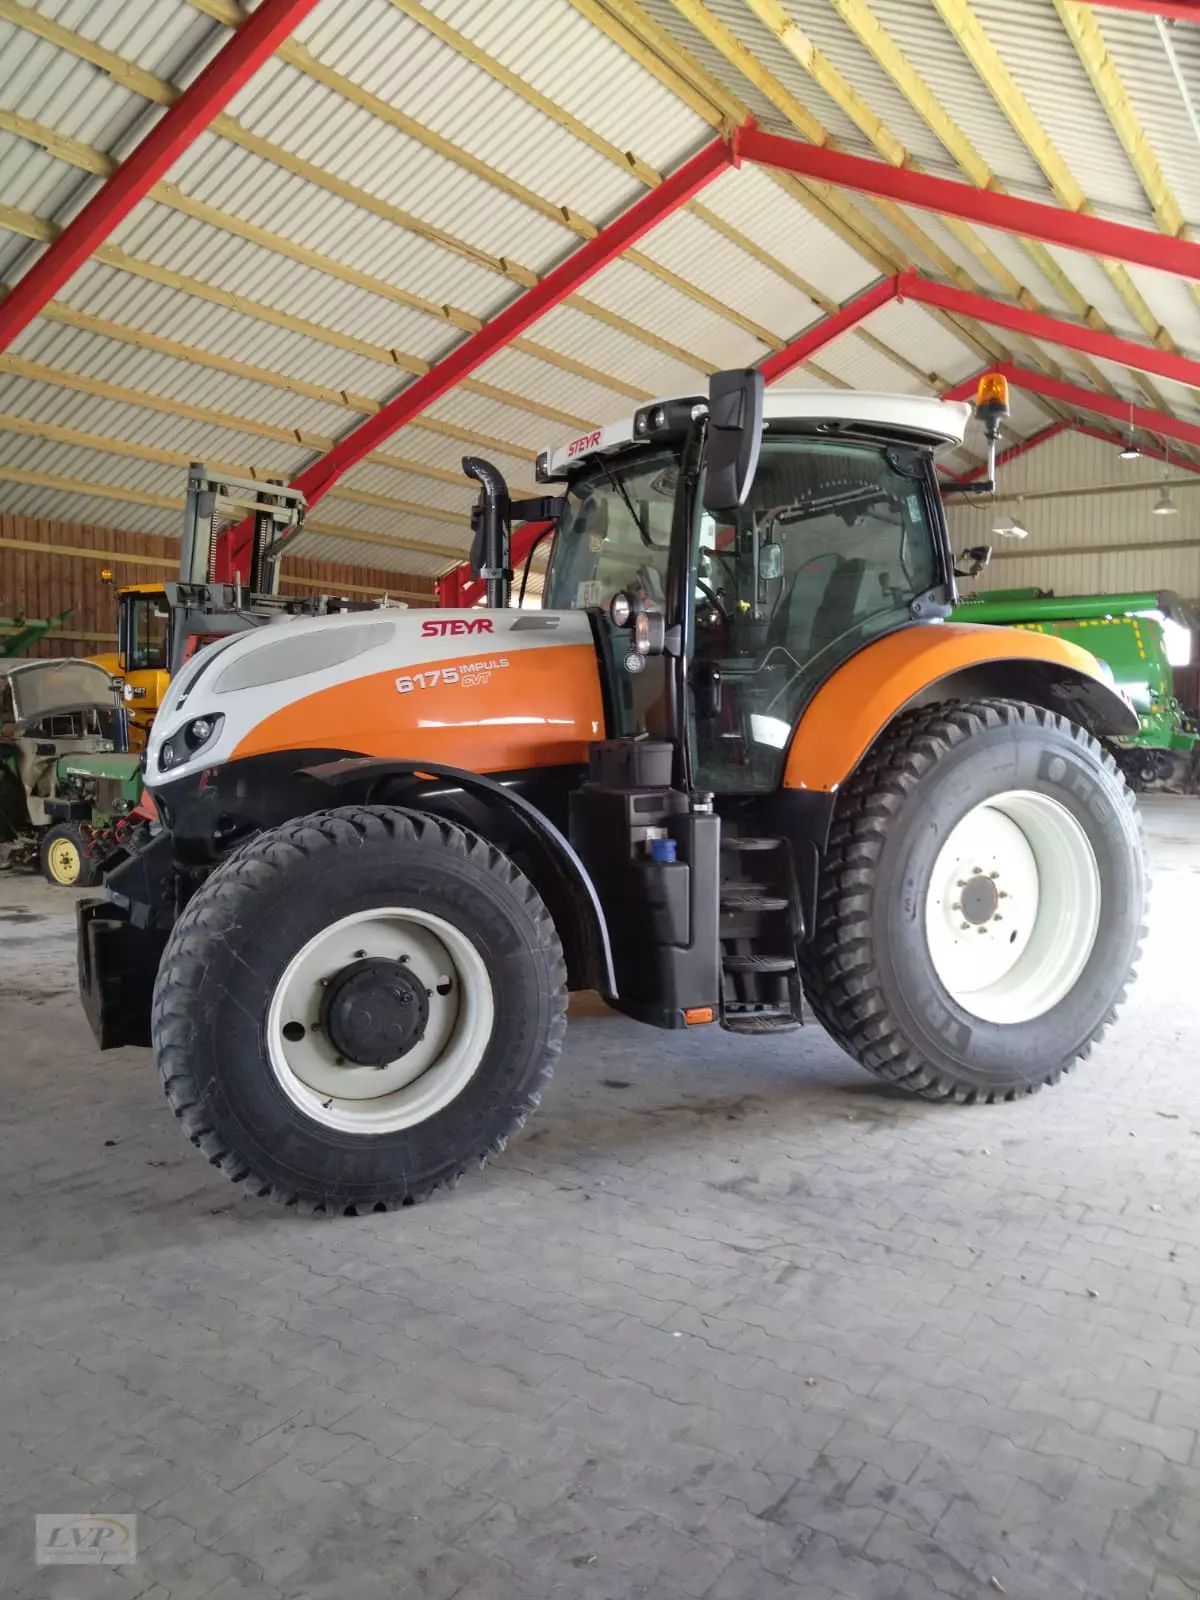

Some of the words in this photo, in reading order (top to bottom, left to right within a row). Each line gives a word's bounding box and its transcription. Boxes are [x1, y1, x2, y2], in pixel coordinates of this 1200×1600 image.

[568, 431, 601, 457] STEYR
[421, 618, 495, 638] STEYR
[395, 667, 459, 694] 6175
[459, 658, 510, 674] IMPULS
[461, 672, 491, 687] CVT
